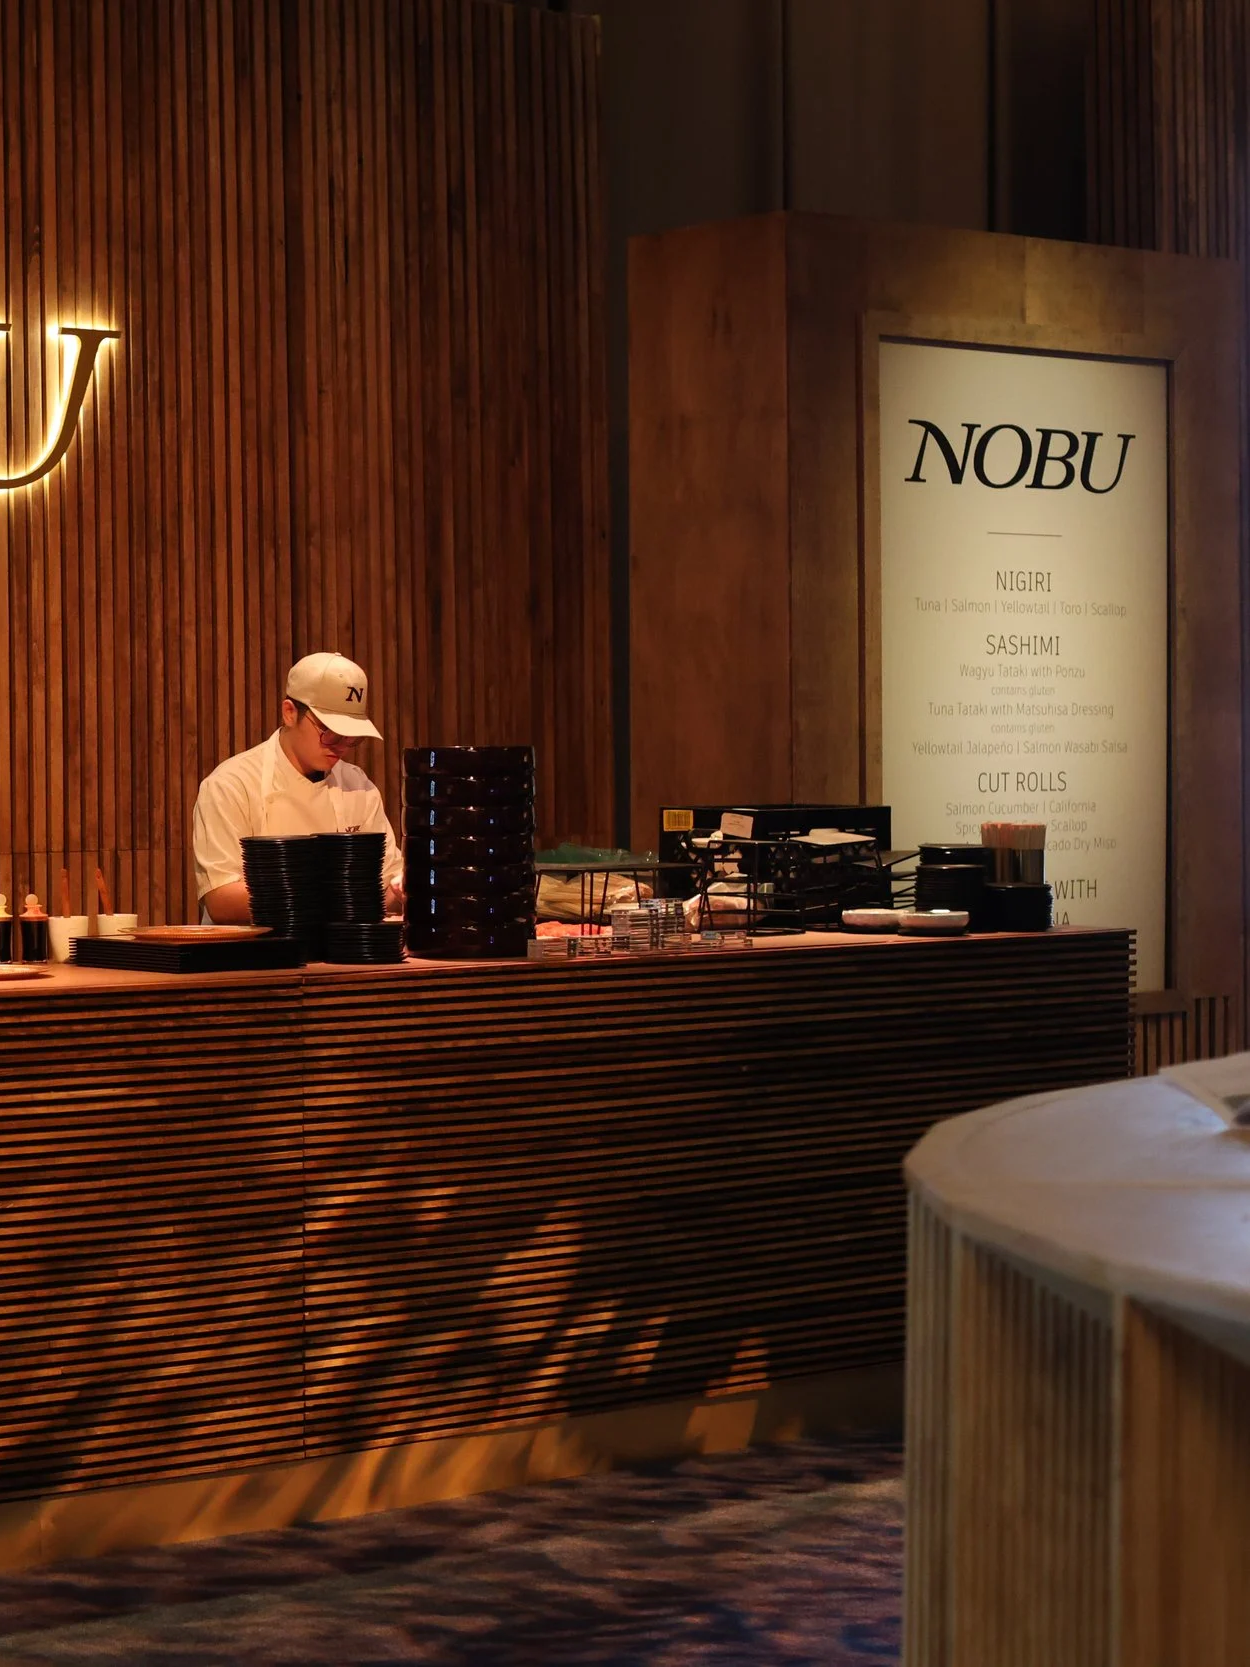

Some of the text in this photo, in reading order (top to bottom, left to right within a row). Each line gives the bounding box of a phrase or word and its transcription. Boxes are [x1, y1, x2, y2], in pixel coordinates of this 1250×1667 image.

[904, 418, 1136, 494] NOBU
[996, 570, 1052, 592] NIGIRI
[915, 597, 941, 613] Tuna
[951, 598, 991, 614] Salmon
[1001, 600, 1050, 615] Yellowtail
[1060, 601, 1082, 616] Toro
[1091, 602, 1127, 618] Scallop
[986, 634, 1060, 656] SASHIMI
[959, 663, 1086, 681] Wagyu Tataki with Ponzu
[345, 686, 364, 703] N
[991, 685, 1056, 698] contains gluten
[928, 701, 1114, 719] Tuna Tataki with Matsuhisa Dressing
[991, 722, 1055, 735] contains gluten
[912, 741, 963, 756] Yellowtail
[1023, 740, 1061, 754] Salmon
[1064, 740, 1099, 754] Wasabi
[1101, 740, 1128, 754] Salsa
[978, 771, 1067, 793] CUT ROLLS
[945, 802, 986, 817] Salmon
[988, 802, 1040, 817] Cucumber
[1050, 800, 1097, 814] California
[1051, 819, 1088, 834] Scallop
[1074, 837, 1090, 854] Dry
[1093, 836, 1117, 849] Miso
[1054, 879, 1097, 900] WITH
